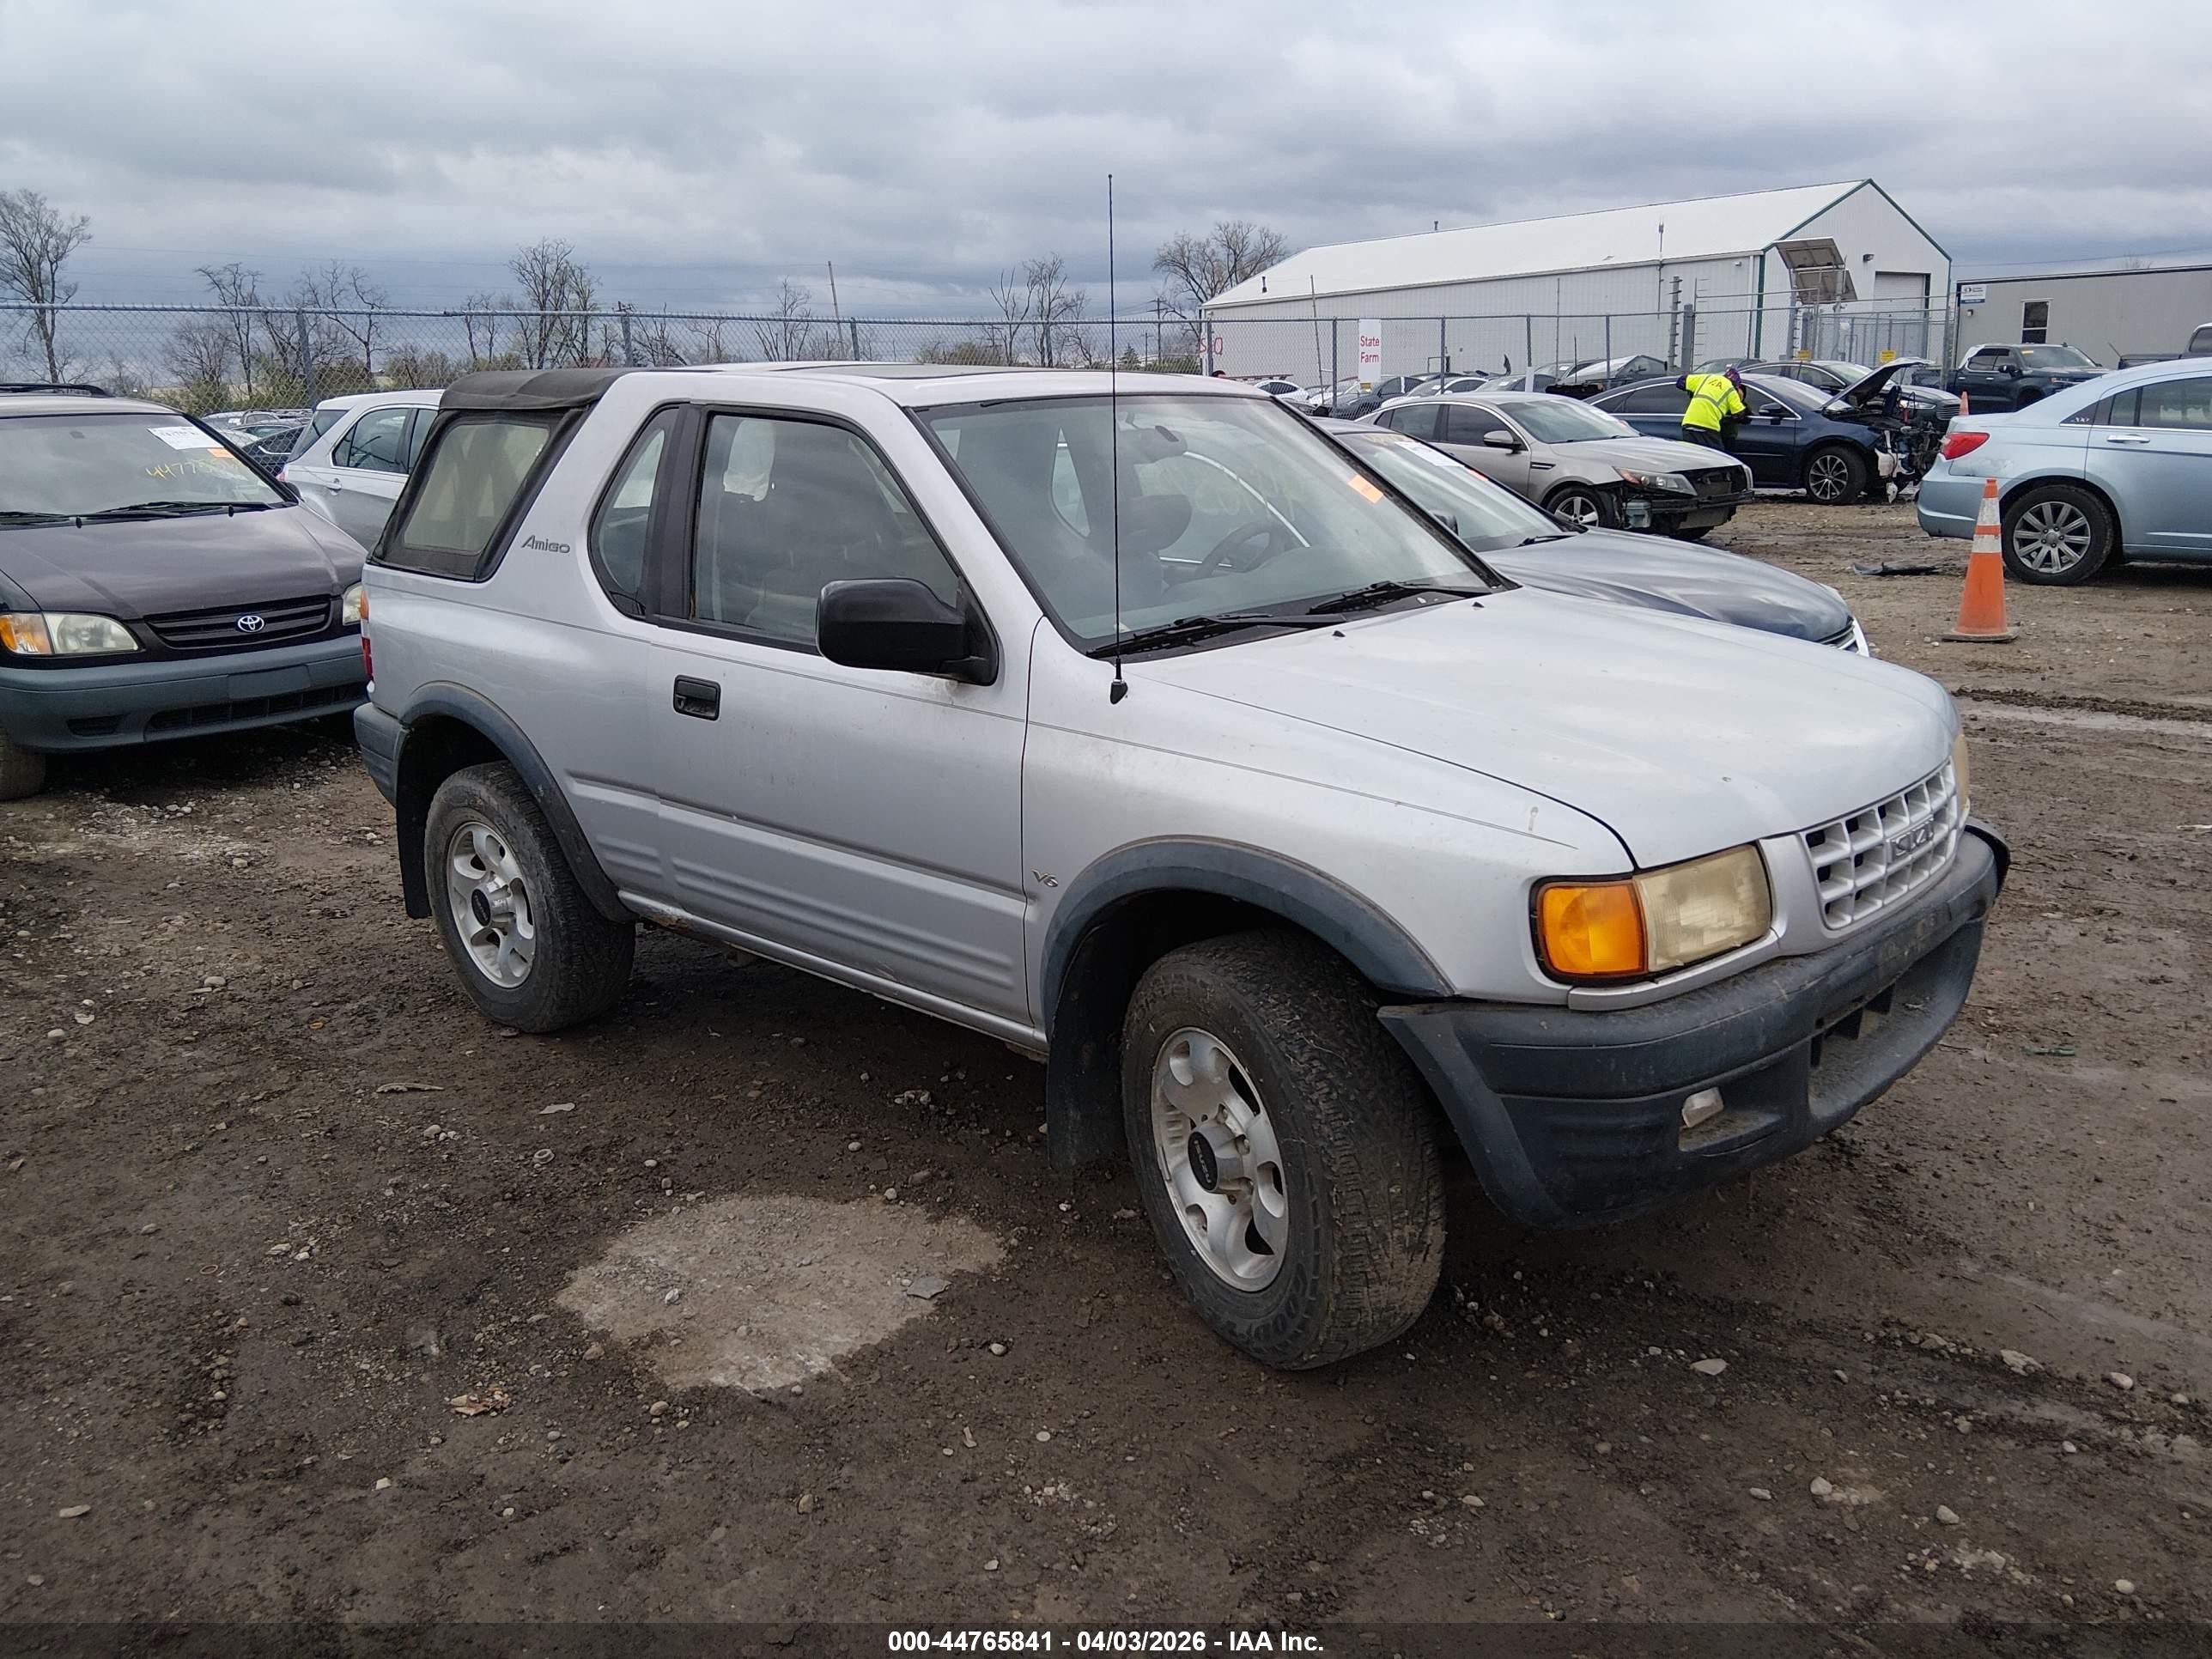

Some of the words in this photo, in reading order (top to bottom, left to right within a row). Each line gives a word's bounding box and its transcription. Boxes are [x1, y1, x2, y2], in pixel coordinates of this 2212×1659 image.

[1359, 335, 1380, 347] State
[1360, 351, 1379, 364] Farm
[1030, 868, 1059, 888] V6
